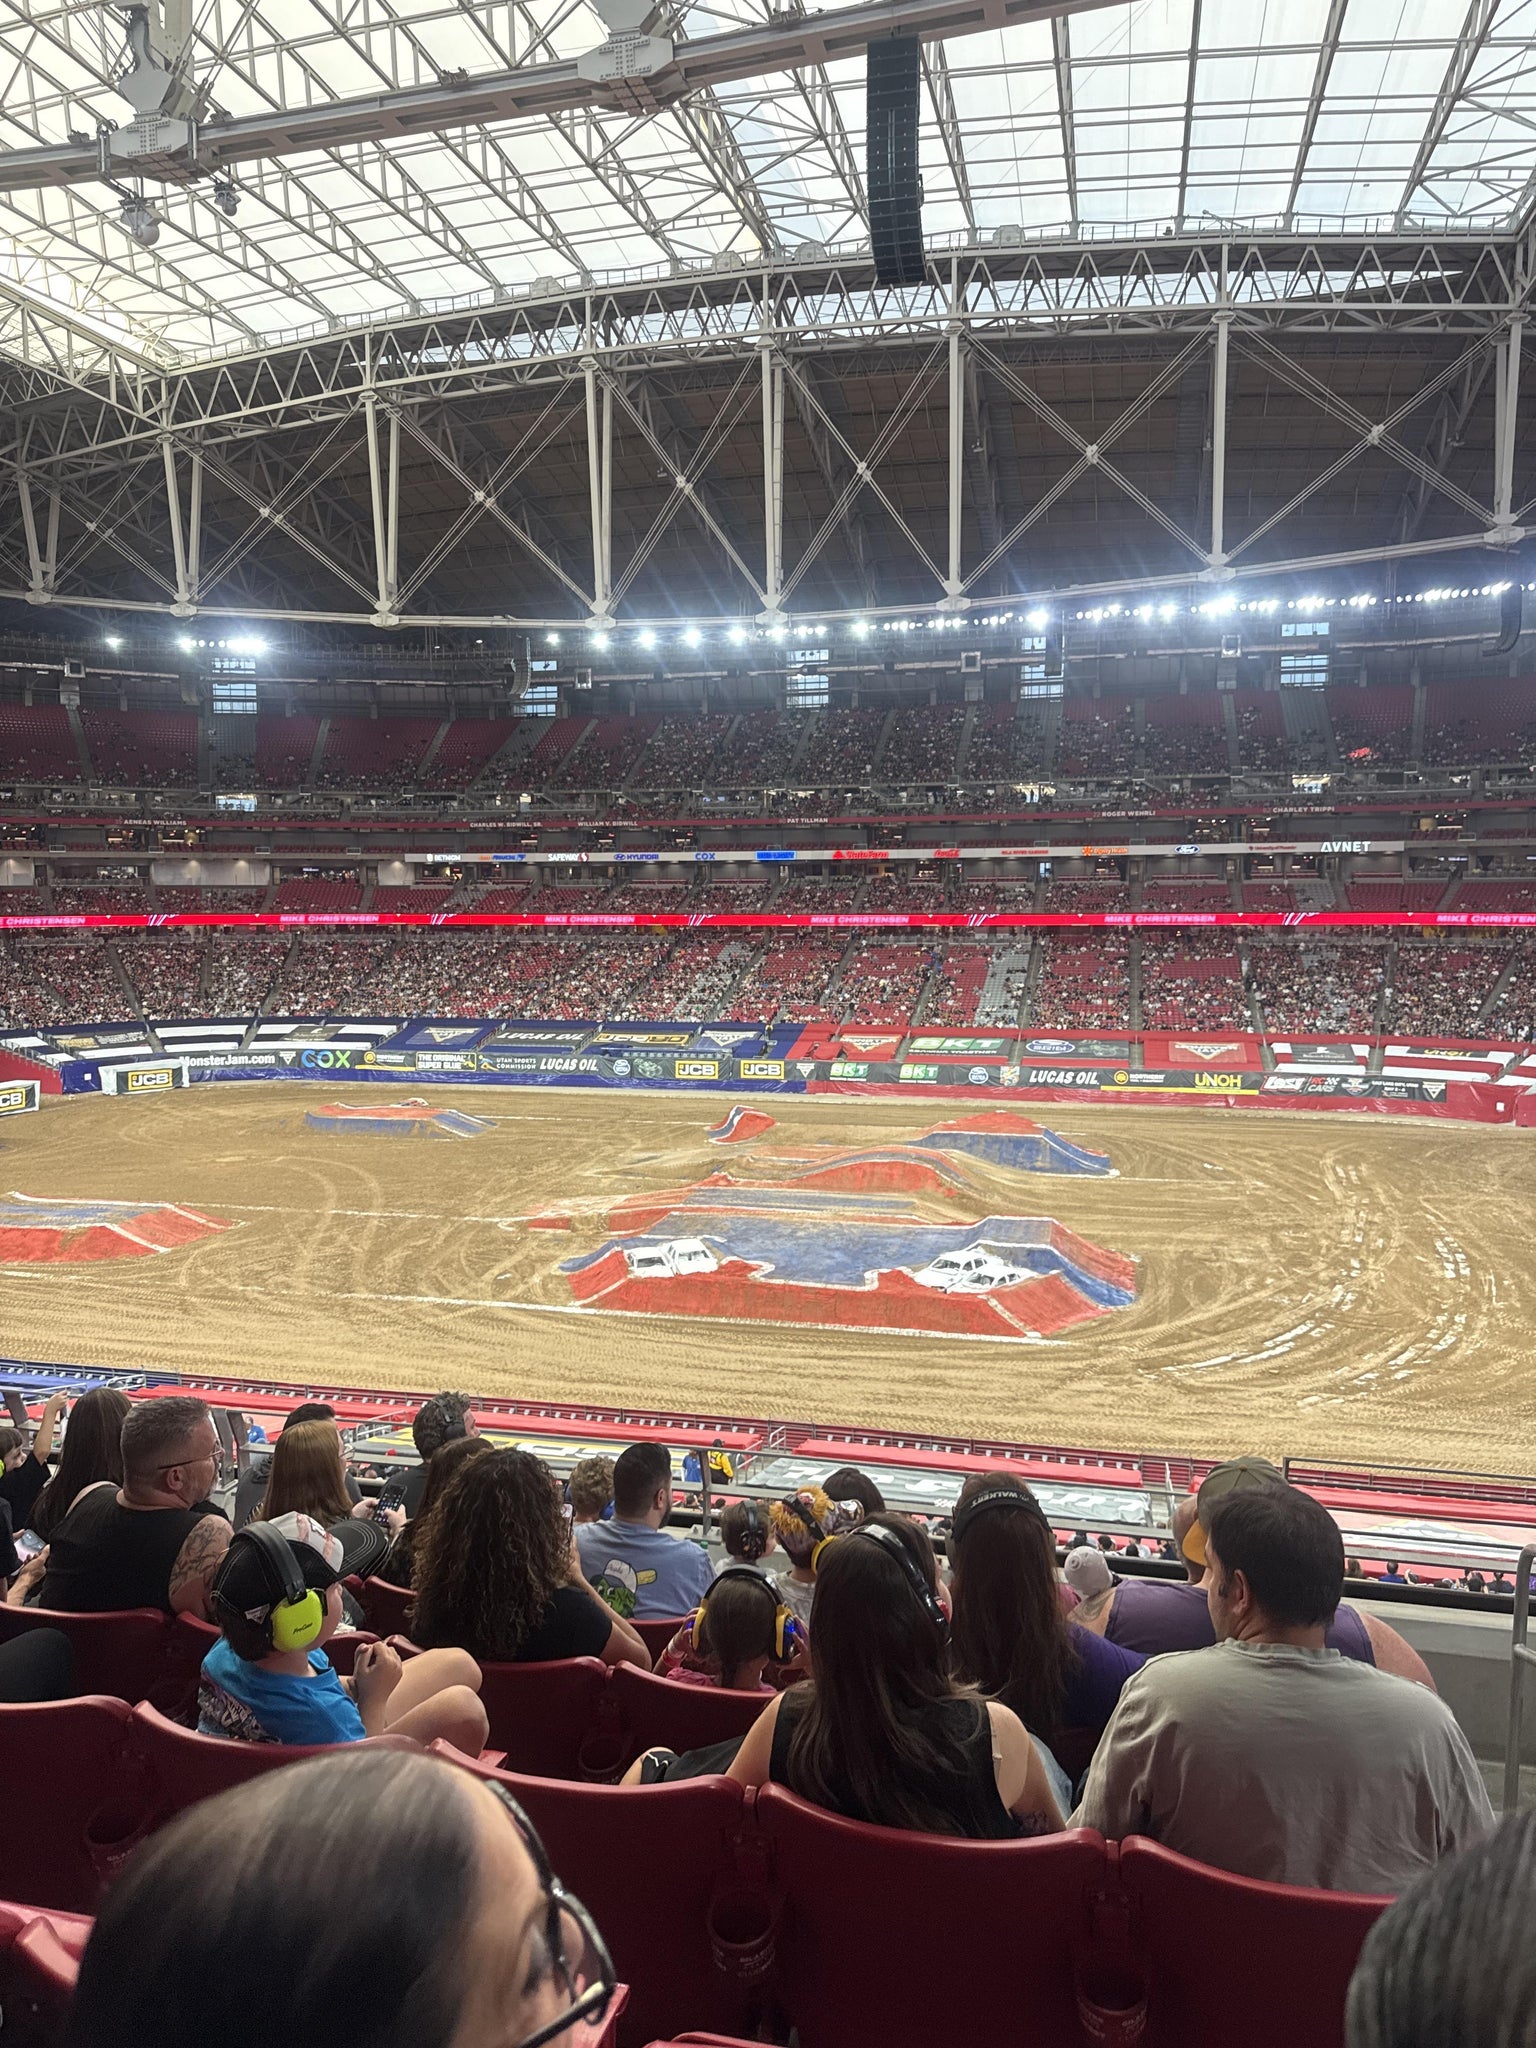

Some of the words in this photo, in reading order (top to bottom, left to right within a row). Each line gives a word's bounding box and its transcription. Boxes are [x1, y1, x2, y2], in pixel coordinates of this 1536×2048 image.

[1320, 841, 1371, 853] AVNET
[548, 853, 580, 862] SAFEWAY
[6, 917, 85, 926] CHRISTENSEN
[280, 915, 305, 924] MIKE
[307, 915, 379, 924] CHRISTENSEN
[544, 915, 568, 924] MIKE
[569, 915, 636, 924] CHRISTENSEN
[810, 915, 835, 924] MIKE
[836, 915, 909, 924] CHRISTENSEN
[1104, 914, 1132, 923] MIKE
[1135, 914, 1216, 923] CHRISTENSEN
[1436, 914, 1468, 922] MIKE
[496, 1032, 555, 1040] LUCAS
[555, 1032, 586, 1041] OIL
[912, 1037, 1004, 1049] BKT
[301, 1049, 351, 1069] COX
[418, 1061, 442, 1069] SUPER
[540, 1058, 578, 1071] LUCAS
[578, 1058, 599, 1072] OIL
[679, 1063, 715, 1076] JCB
[743, 1063, 782, 1076] JCB
[830, 1063, 869, 1077] BKT
[900, 1064, 938, 1078] BKT
[131, 1071, 171, 1087] JCB
[1029, 1070, 1074, 1084] LUCAS
[1074, 1071, 1099, 1085] OIL
[1194, 1072, 1242, 1088] UNOH
[1311, 1077, 1326, 1085] RC
[1308, 1084, 1336, 1093] CARS
